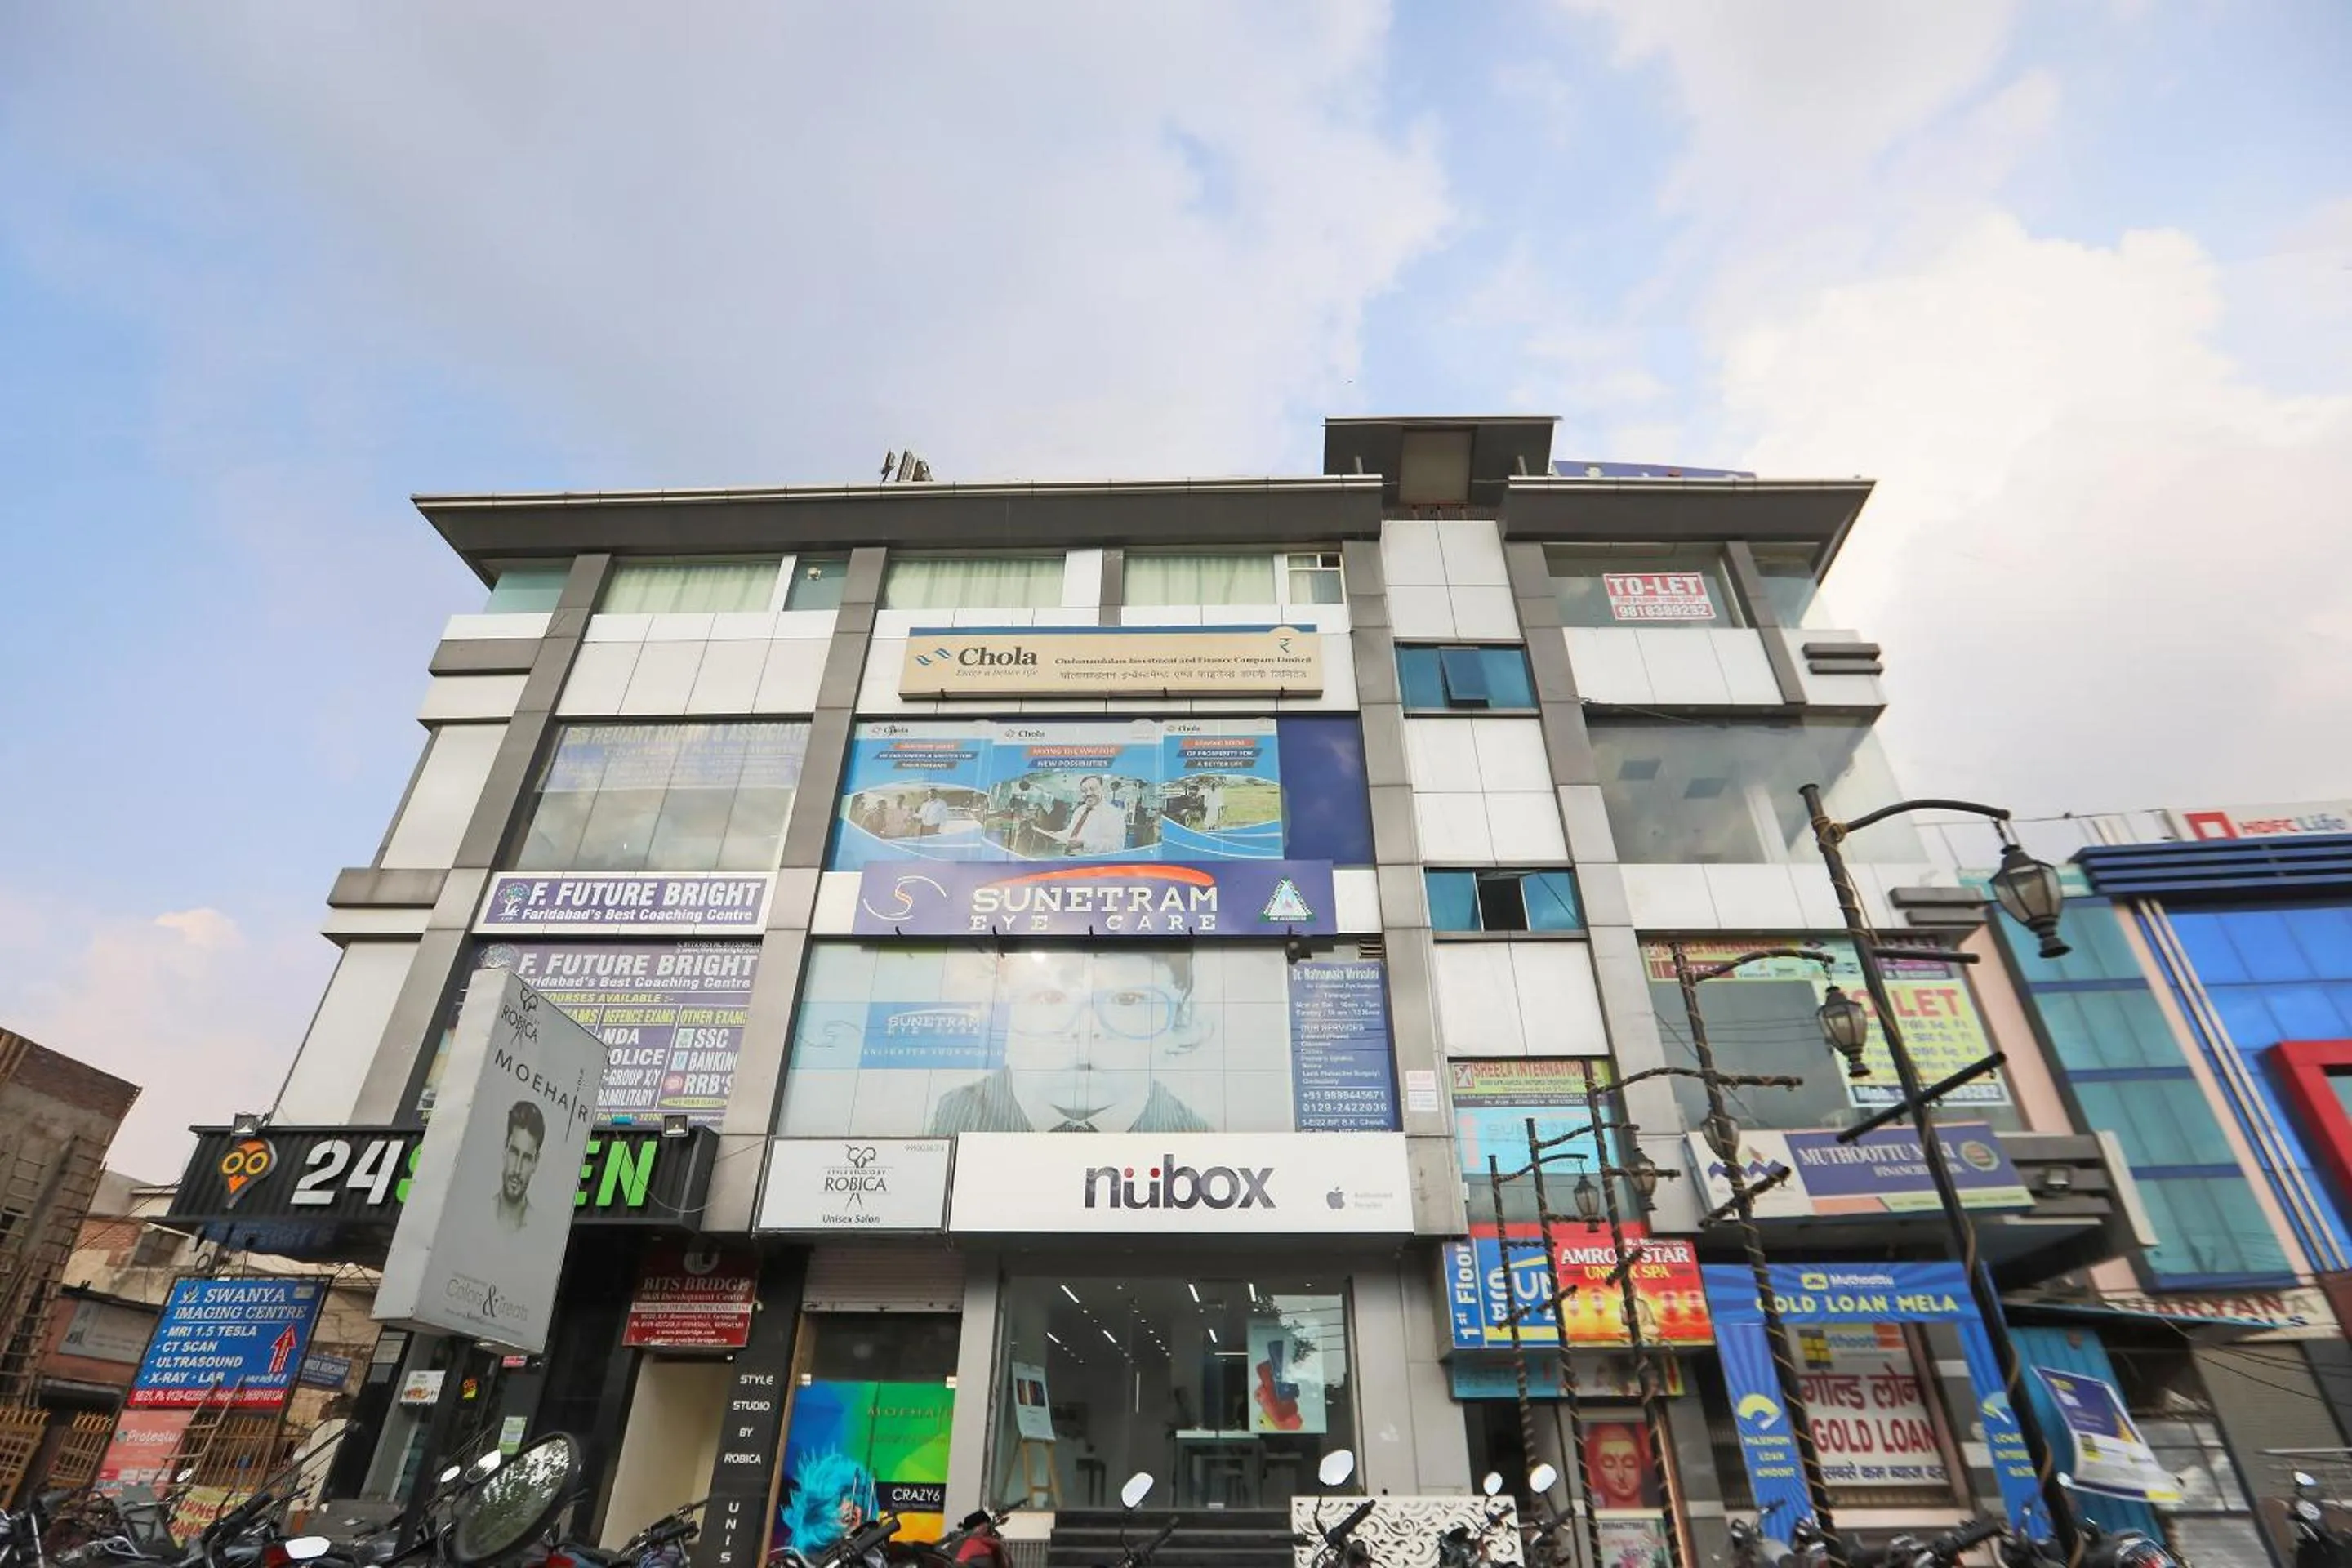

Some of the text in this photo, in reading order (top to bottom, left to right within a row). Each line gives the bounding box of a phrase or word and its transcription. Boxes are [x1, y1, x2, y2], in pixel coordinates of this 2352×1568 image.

[1608, 576, 1699, 595] TO-LET
[958, 646, 1038, 666] Chola
[1037, 760, 1058, 768] NEW
[528, 882, 761, 906] F. FUTURE BRIGHT
[972, 886, 1217, 913] SUNETRAM
[522, 908, 753, 923] Faridabad's Best Coaching Centre
[969, 915, 1216, 930] EYE CARE
[518, 953, 758, 977] F. FUTURE BRIGHT
[599, 977, 630, 987] Best
[635, 977, 698, 990] Coaching
[703, 977, 751, 989] Centre
[599, 993, 660, 1003] AVAILABLE
[1891, 988, 1960, 1018] LET
[681, 1009, 713, 1024] OTHER
[694, 1028, 729, 1049] SSC
[609, 1048, 666, 1065] OLICE
[824, 1177, 887, 1192] ROBICA
[822, 1214, 880, 1224] Unisex Salon
[1640, 1247, 1690, 1263] STAR
[1454, 1244, 1477, 1304] Floor
[1641, 1265, 1672, 1279] SPA
[204, 1287, 287, 1303] SWANYA
[1825, 1294, 1888, 1313] LOAN
[1895, 1294, 1959, 1312] MELA
[173, 1306, 306, 1320] IMAGING CENTRE
[167, 1325, 257, 1337] MRI 1.5 TESLA
[162, 1341, 218, 1352] CT SCAN
[155, 1356, 243, 1369] ULTRASOUND
[149, 1371, 193, 1383] X-RAY
[740, 1374, 773, 1385] STYLE
[733, 1401, 771, 1410] STUDIO
[739, 1428, 753, 1437] BY
[1811, 1417, 1940, 1454] GOLD LOAN
[724, 1453, 761, 1464] ROBICA
